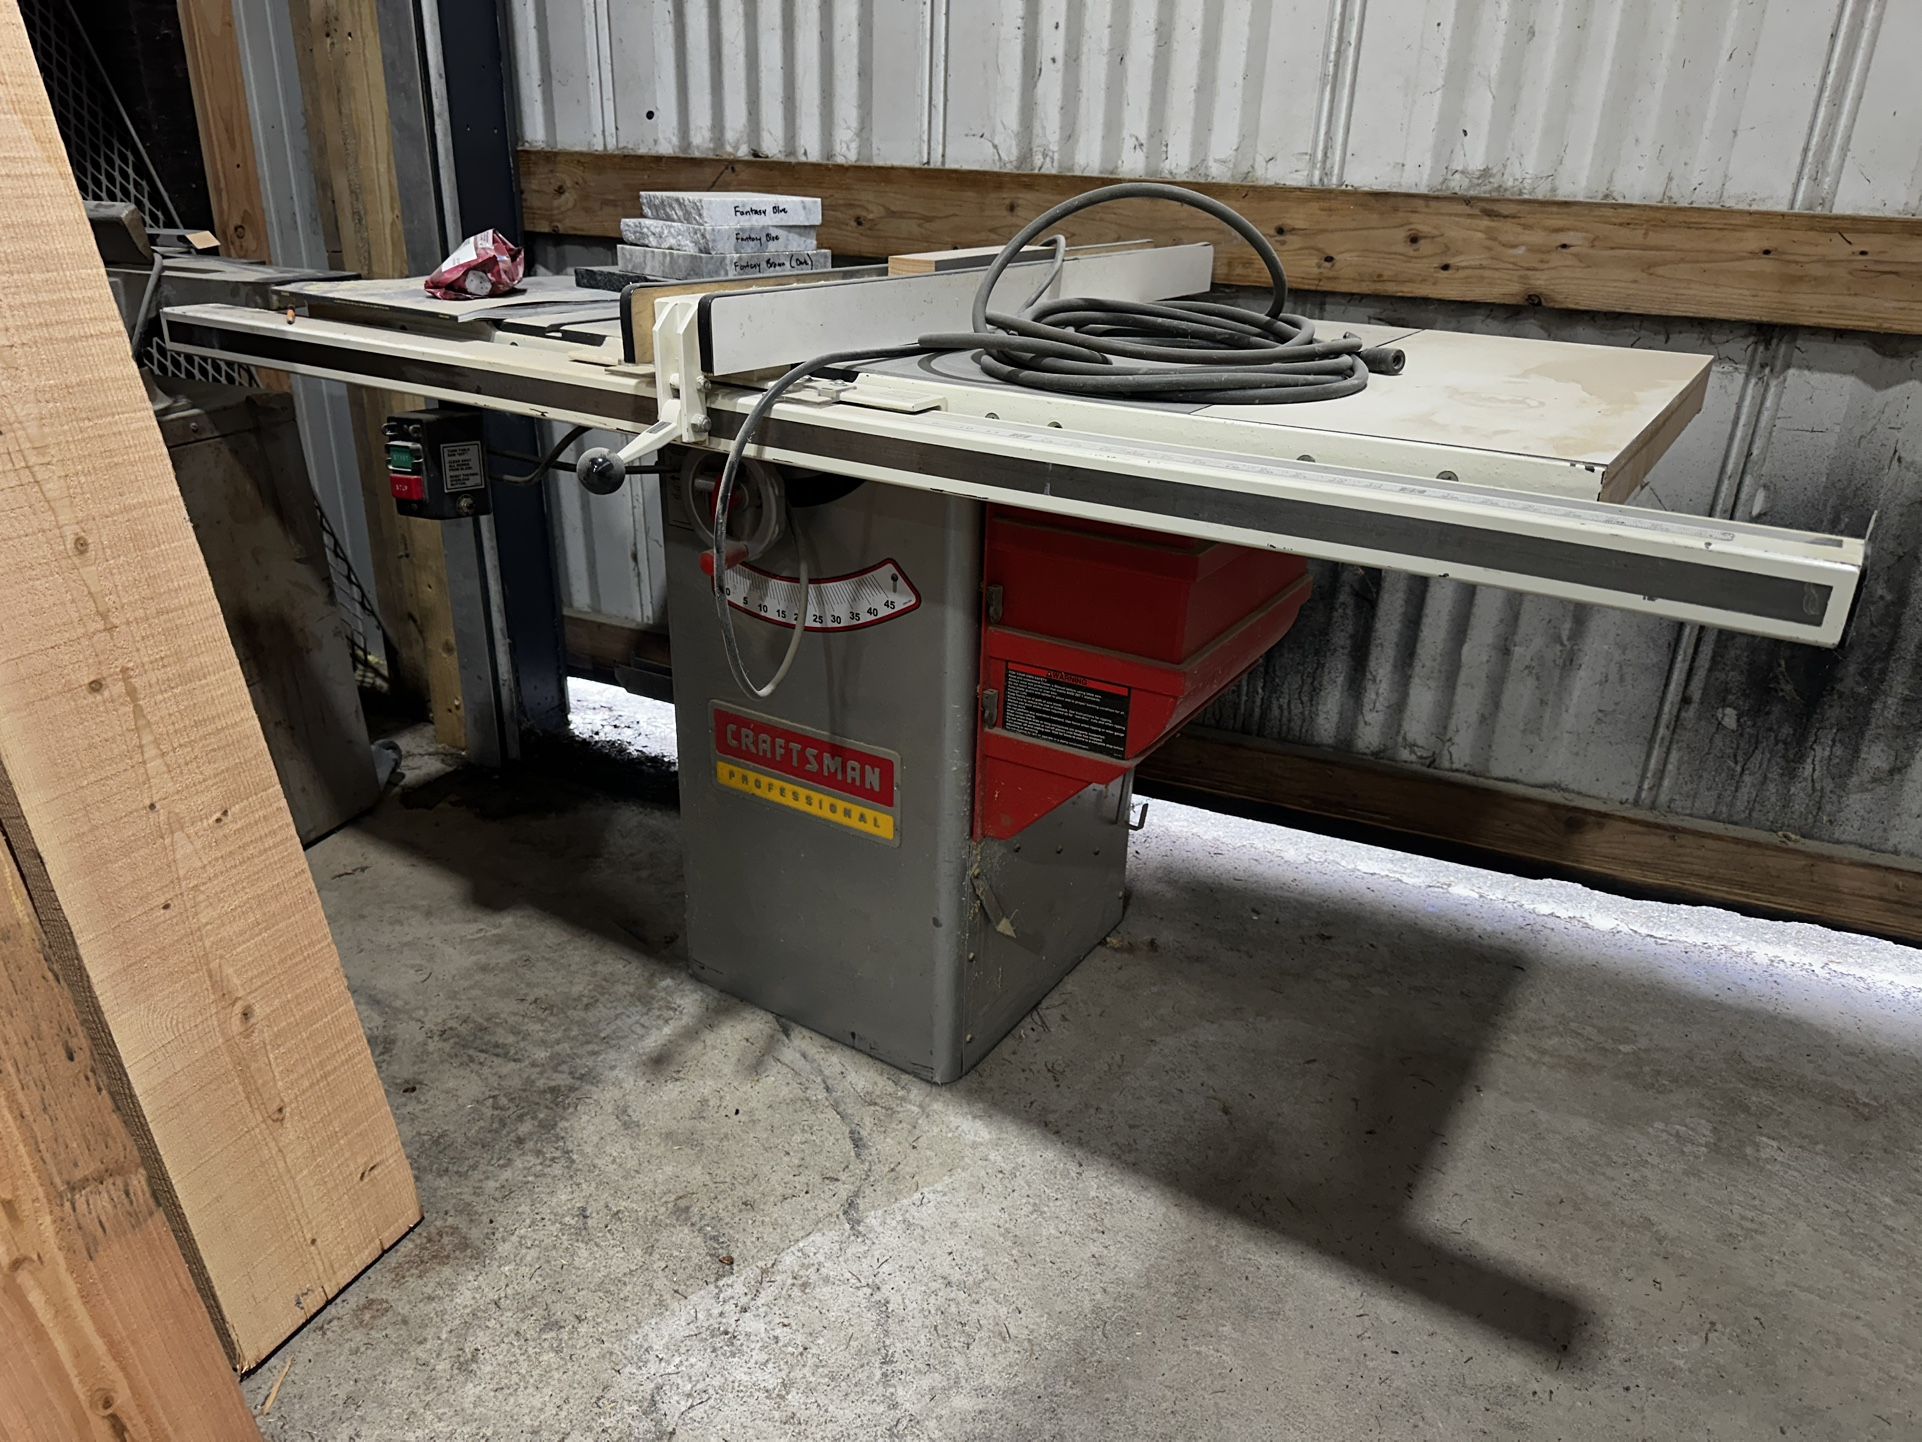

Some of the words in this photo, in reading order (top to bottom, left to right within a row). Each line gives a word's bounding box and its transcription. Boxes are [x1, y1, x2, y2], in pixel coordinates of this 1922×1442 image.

[734, 205, 767, 216] Fantasy
[772, 206, 788, 214] Blue
[735, 233, 762, 247] Fantasy
[734, 262, 761, 273] Fantasy
[765, 258, 786, 269] Brown
[726, 587, 731, 596] 0
[743, 597, 749, 605] 5
[758, 603, 768, 613] 10
[776, 609, 787, 619] 15
[813, 614, 824, 624] 25
[831, 615, 842, 625] 30
[849, 612, 861, 622] 35
[867, 607, 878, 617] 40
[883, 600, 896, 610] 45
[727, 724, 880, 791] CRAFTSMAN
[728, 769, 881, 829] PROFESSIONAL
